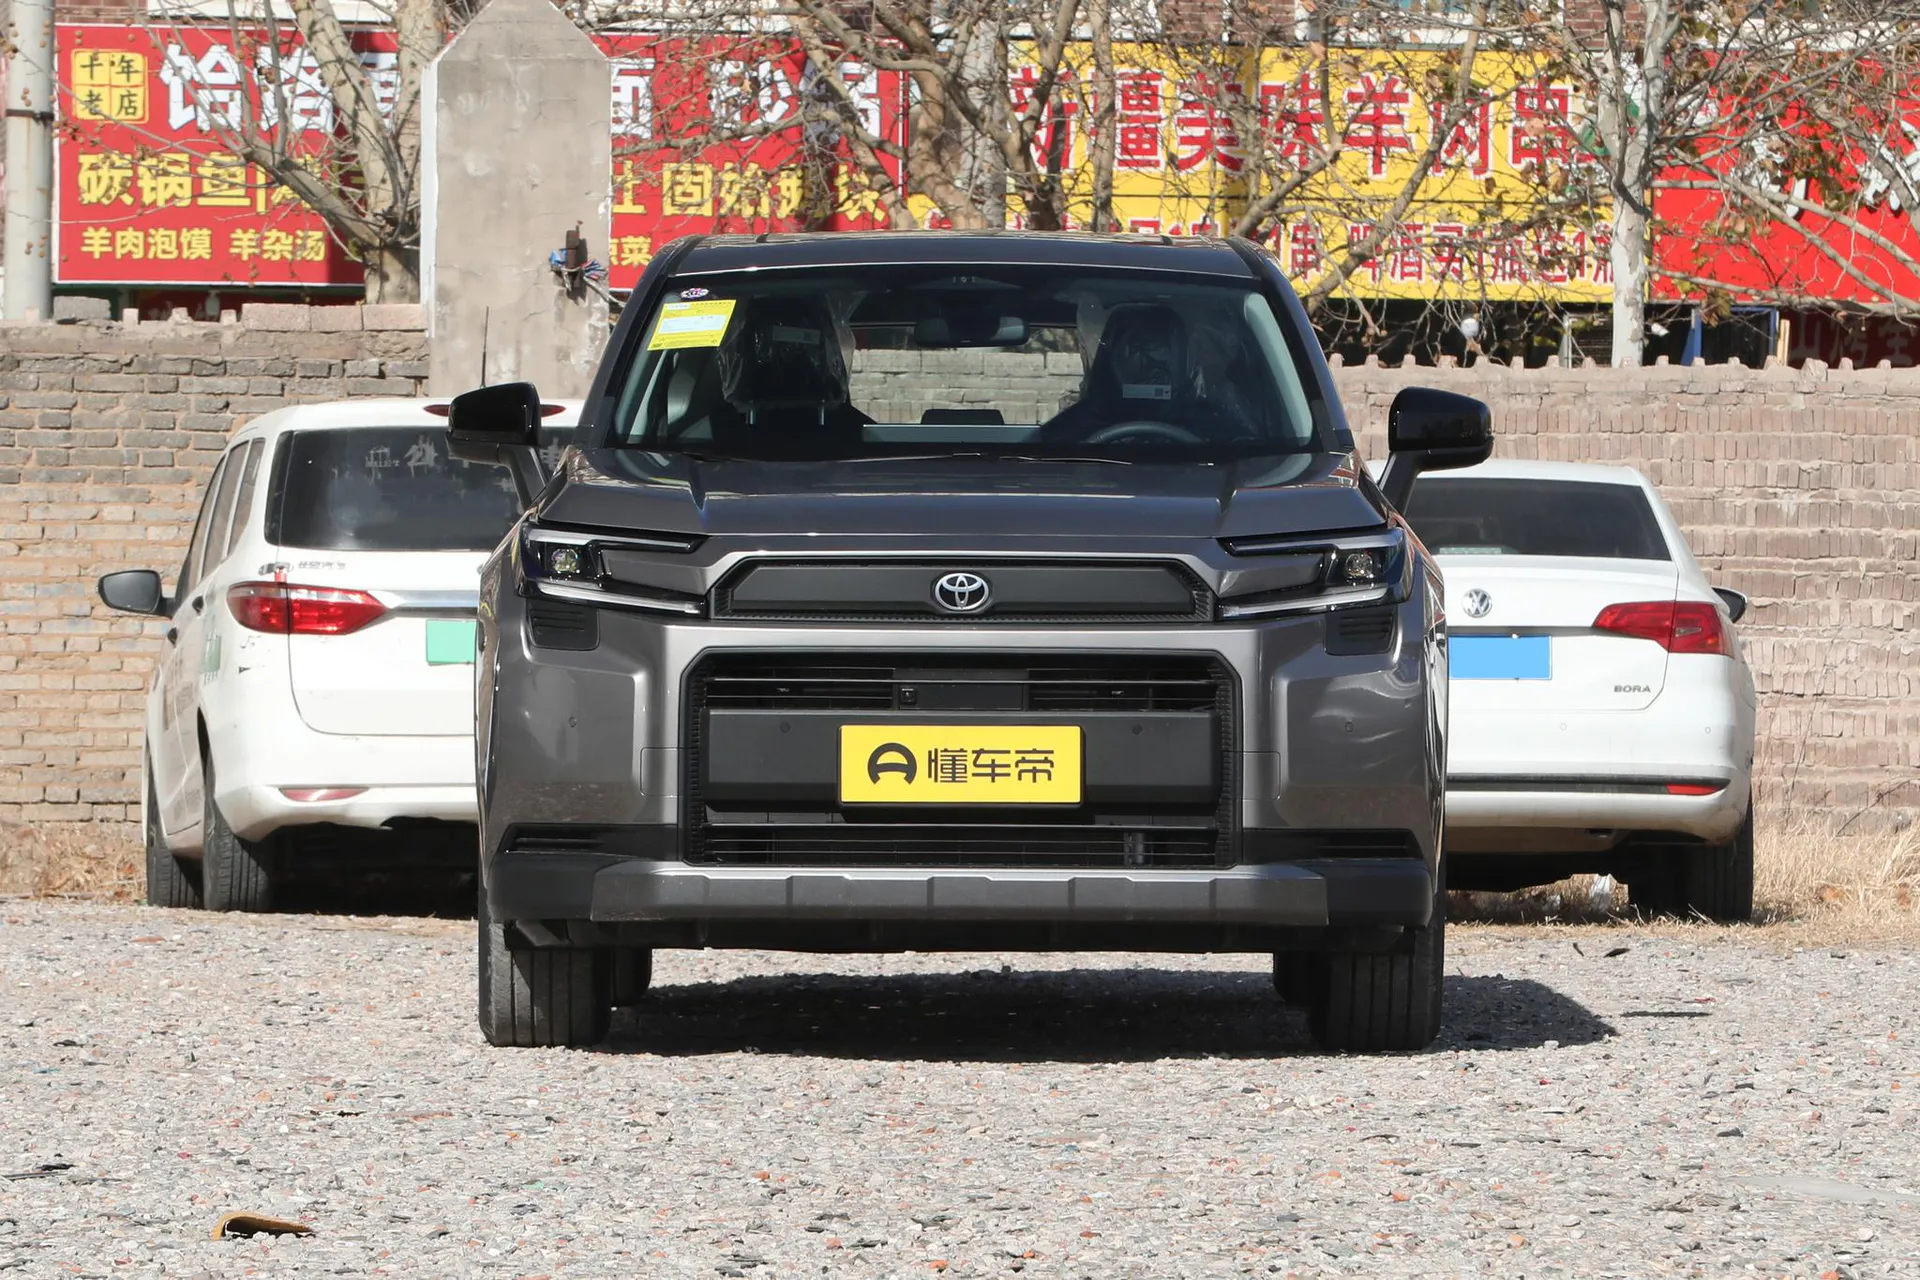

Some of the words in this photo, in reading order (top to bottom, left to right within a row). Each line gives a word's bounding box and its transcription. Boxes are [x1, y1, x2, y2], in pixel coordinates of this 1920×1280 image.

[80, 89, 138, 117] 老店
[81, 227, 213, 260] 羊肉泡馍
[229, 228, 326, 262] 羊杂汤
[610, 235, 653, 268] 菜
[1613, 684, 1652, 694] BORA
[928, 747, 1055, 784] 懂车帝
